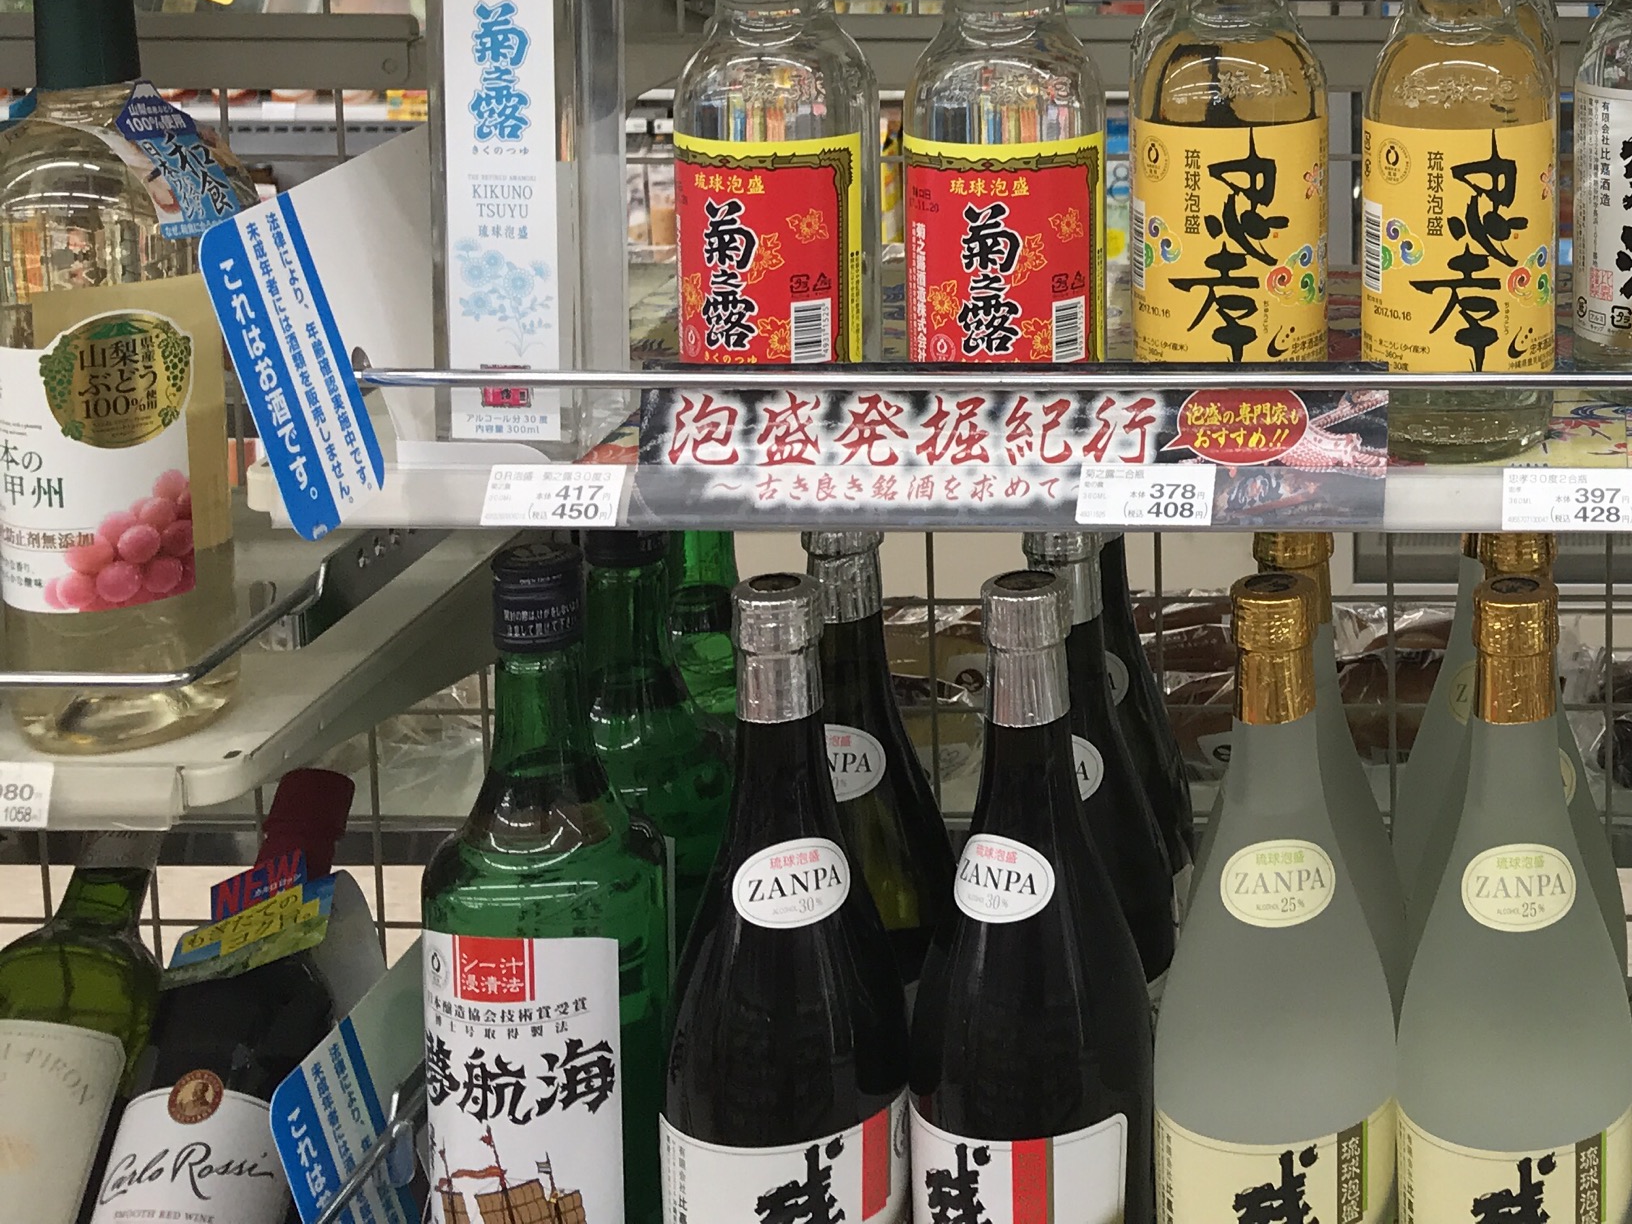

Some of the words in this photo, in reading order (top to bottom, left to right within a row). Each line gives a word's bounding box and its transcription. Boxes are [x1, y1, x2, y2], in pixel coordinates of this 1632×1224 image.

[471, 144, 530, 156] きくのつゆ
[1600, 101, 1611, 207] 有限会社比嘉酒造
[472, 184, 533, 200] KIKUNO
[693, 173, 766, 195] 琉球泡盛
[949, 175, 1030, 197] 琉球泡盛
[1183, 148, 1201, 236] 琉球泡盛
[1425, 150, 1445, 237] 琉球泡盛
[476, 203, 529, 218] TSUYU
[478, 225, 528, 240] 琉球泡盛
[702, 197, 756, 351] 菊之露
[958, 201, 1021, 354] 菊之露
[244, 220, 356, 506] 未成年者には酒類を販売しません。
[78, 367, 158, 396] ぶどう
[218, 258, 319, 502] これはお酒です。
[1185, 402, 1300, 425] 泡盛の専門家も
[667, 390, 1157, 467] 泡盛発掘紀行
[1193, 428, 1290, 448] おすすめ!!
[3, 474, 65, 508] 甲州
[768, 849, 822, 870] 琉球泡盛
[975, 844, 1019, 864] 琉球泡盛
[1255, 850, 1306, 867] 琉球泡盛
[1495, 854, 1546, 870] 琉球泡盛
[215, 848, 303, 921] NEW
[746, 864, 844, 903] ZANPA
[958, 858, 1039, 898] ZANPA
[1233, 868, 1327, 895] ZANPA
[1474, 873, 1568, 899] ZANPA
[100, 1149, 171, 1206] Carlo
[171, 1141, 275, 1202] Rossi
[159, 1210, 181, 1221] RED
